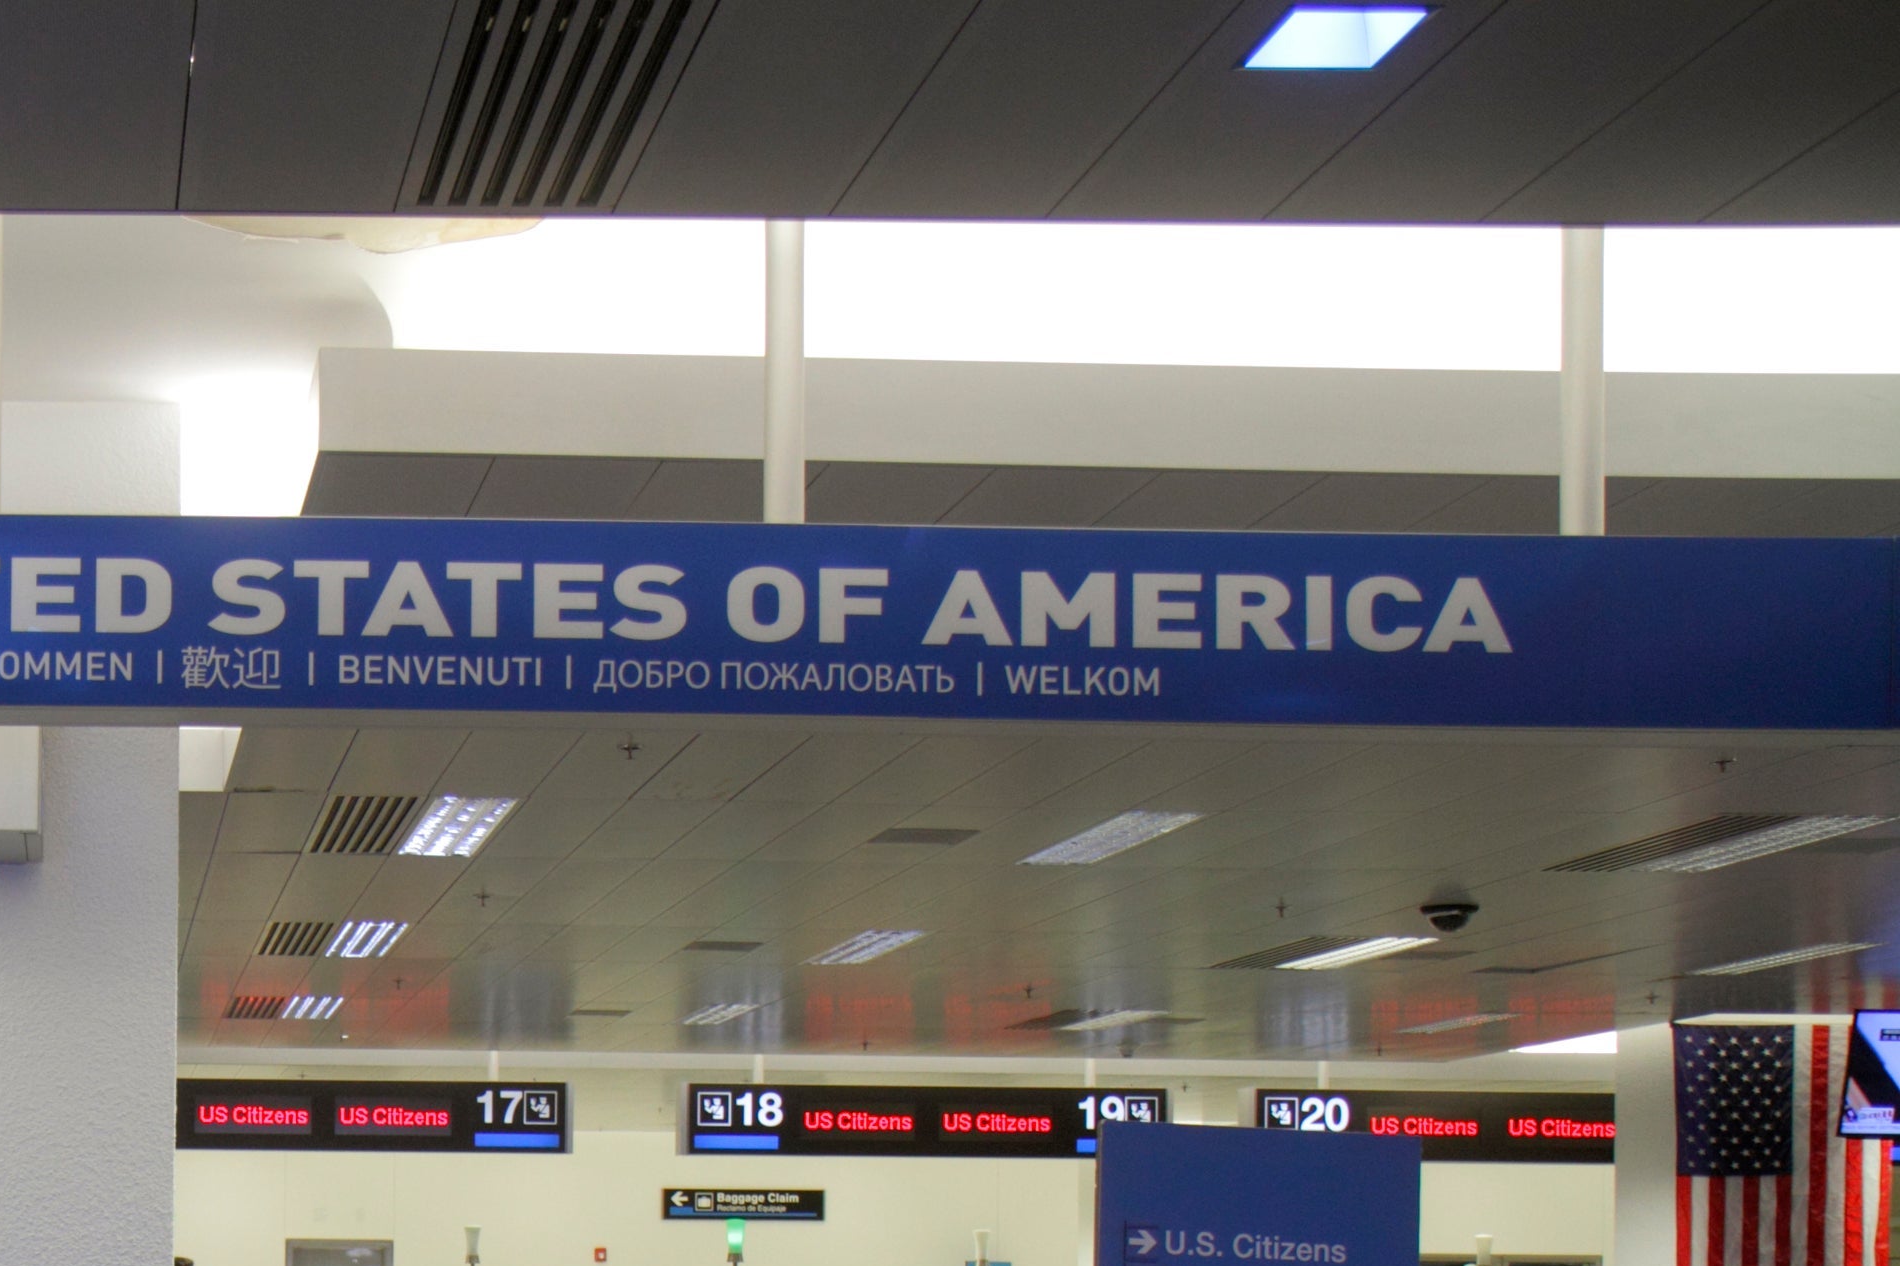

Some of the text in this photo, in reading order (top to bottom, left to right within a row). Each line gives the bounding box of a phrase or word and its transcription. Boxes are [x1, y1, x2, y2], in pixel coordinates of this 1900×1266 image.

[207, 558, 688, 641] STATES
[726, 565, 889, 644] OF
[921, 570, 1513, 653] AMERICA
[181, 646, 281, 690] 歡迎
[338, 655, 541, 687] BENVENUTI
[593, 659, 955, 694] ДОБРО ПОЖАЛОВАТЬ
[1005, 665, 1160, 697] WELKOM
[199, 1106, 309, 1126] US Citizens
[339, 1107, 449, 1127] US Citizens
[476, 1090, 524, 1126] 17
[735, 1092, 784, 1127] 18
[804, 1112, 913, 1132] US Citizens
[943, 1113, 1052, 1133] US Citizens
[1077, 1095, 1125, 1130] 19
[1300, 1097, 1350, 1132] 20
[1370, 1116, 1479, 1137] US Citizens
[1508, 1118, 1616, 1139] US Citizens
[716, 1192, 800, 1205] Baggage Claim
[1164, 1229, 1348, 1264] U.S. Citizens
